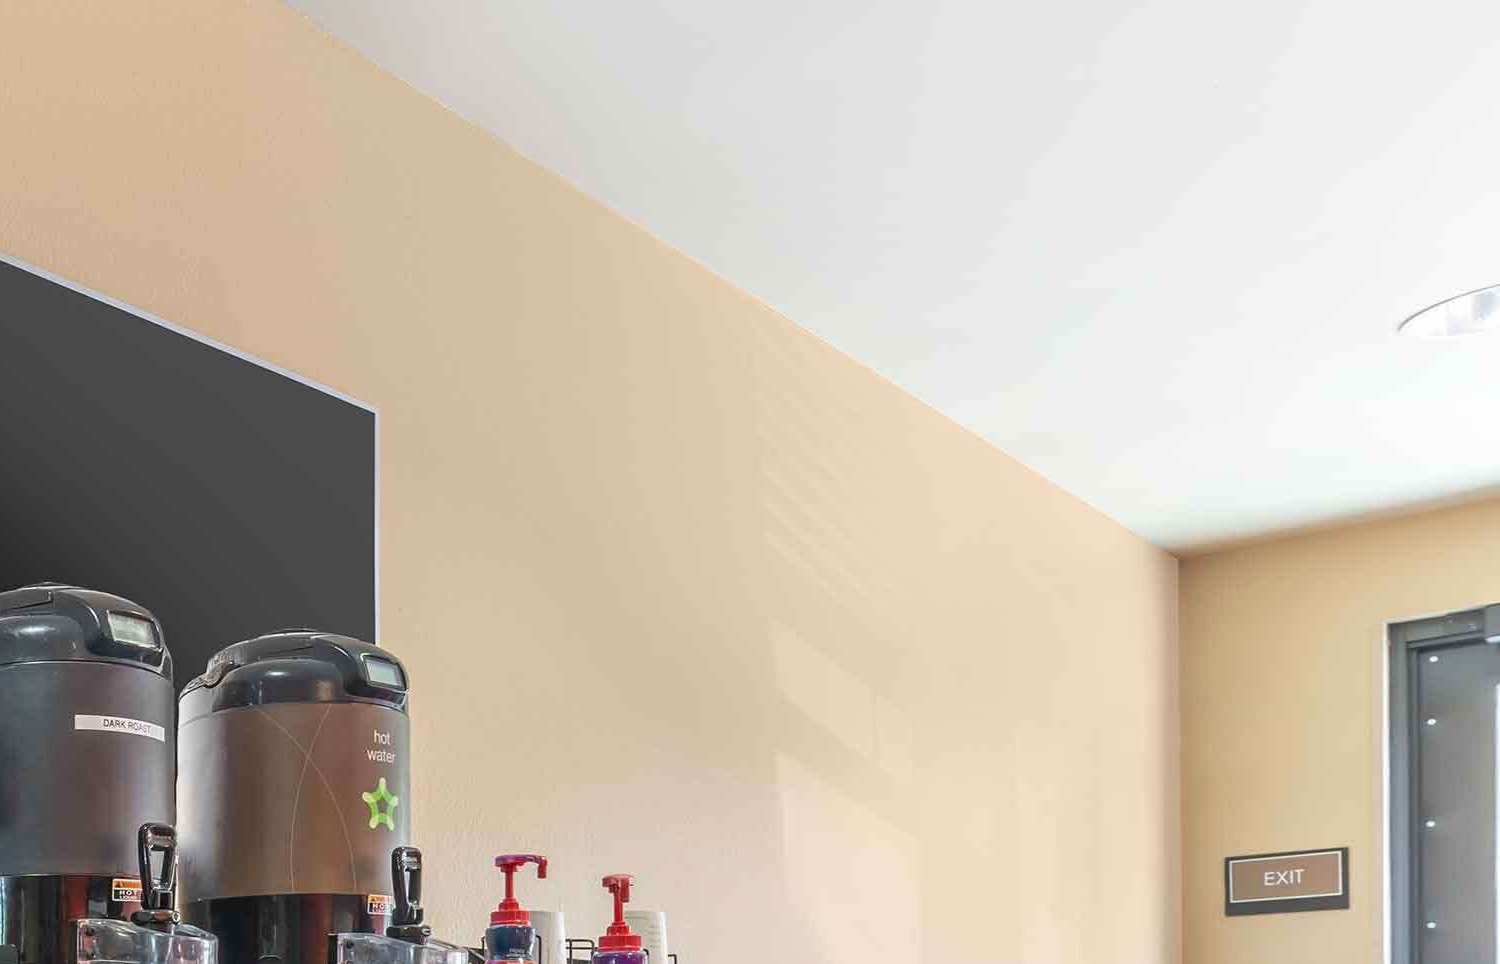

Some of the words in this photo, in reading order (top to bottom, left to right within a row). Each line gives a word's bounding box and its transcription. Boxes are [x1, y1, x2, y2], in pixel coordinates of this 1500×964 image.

[103, 718, 127, 729] DARK
[373, 729, 391, 745] hot
[364, 749, 397, 763] water
[1264, 869, 1305, 886] EXIT
